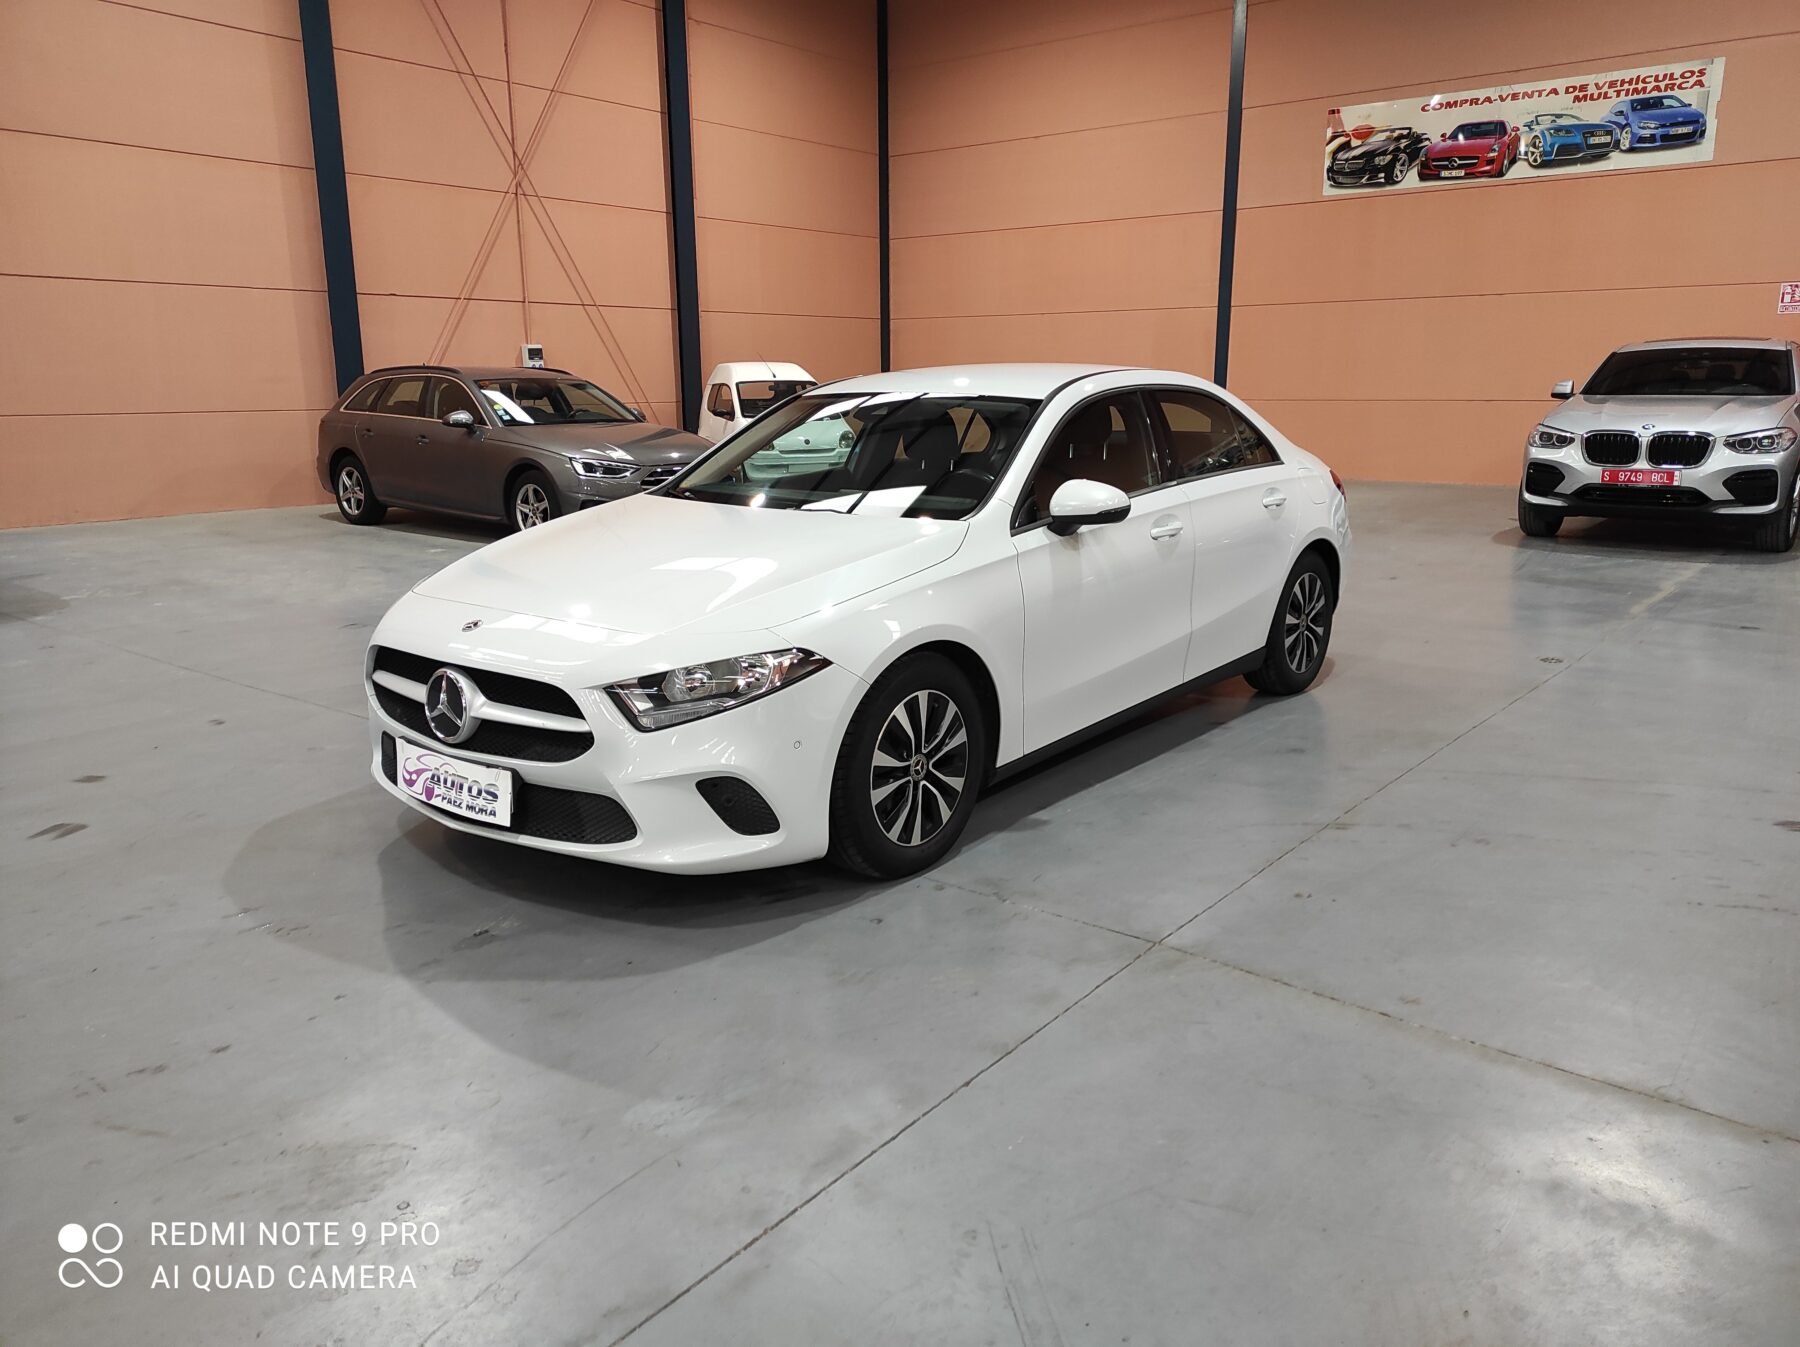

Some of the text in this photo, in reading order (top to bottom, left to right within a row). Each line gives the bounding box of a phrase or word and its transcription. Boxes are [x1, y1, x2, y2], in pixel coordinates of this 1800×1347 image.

[1420, 67, 1707, 112] COMPRA-VENTA DE VEHÍCULOS
[1572, 79, 1705, 104] MULTIMARCA
[1603, 471, 1610, 481] S
[1618, 471, 1643, 482] 9749
[1651, 472, 1670, 483] BCL
[429, 767, 500, 804] AUTOS
[441, 793, 497, 818] PAEZ MORA
